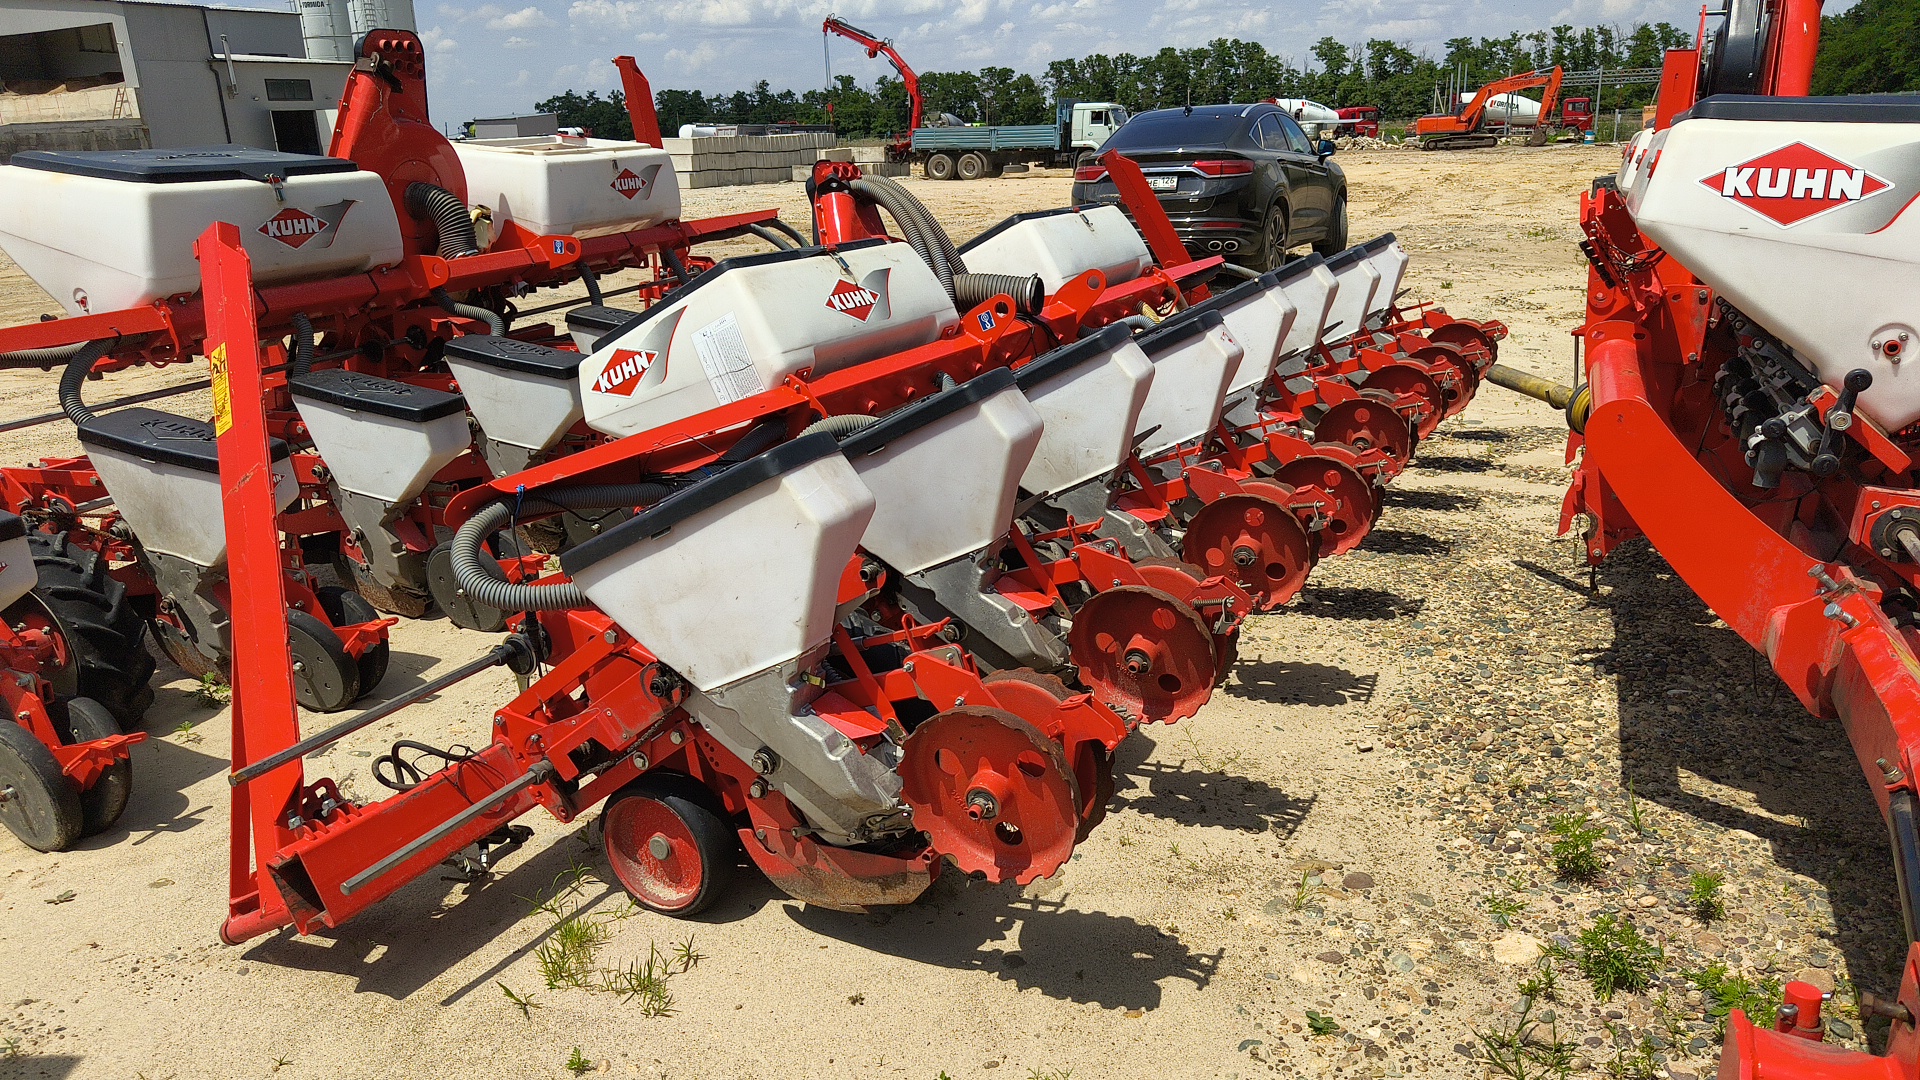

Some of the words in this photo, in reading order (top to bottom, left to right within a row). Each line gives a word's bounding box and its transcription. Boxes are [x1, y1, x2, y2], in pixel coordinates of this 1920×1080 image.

[614, 178, 643, 191] KUHN
[1162, 176, 1175, 185] 126
[1721, 167, 1865, 200] KUHN
[266, 217, 320, 237] KUHN
[829, 289, 876, 311] KUHN
[597, 350, 650, 393] KUHN
